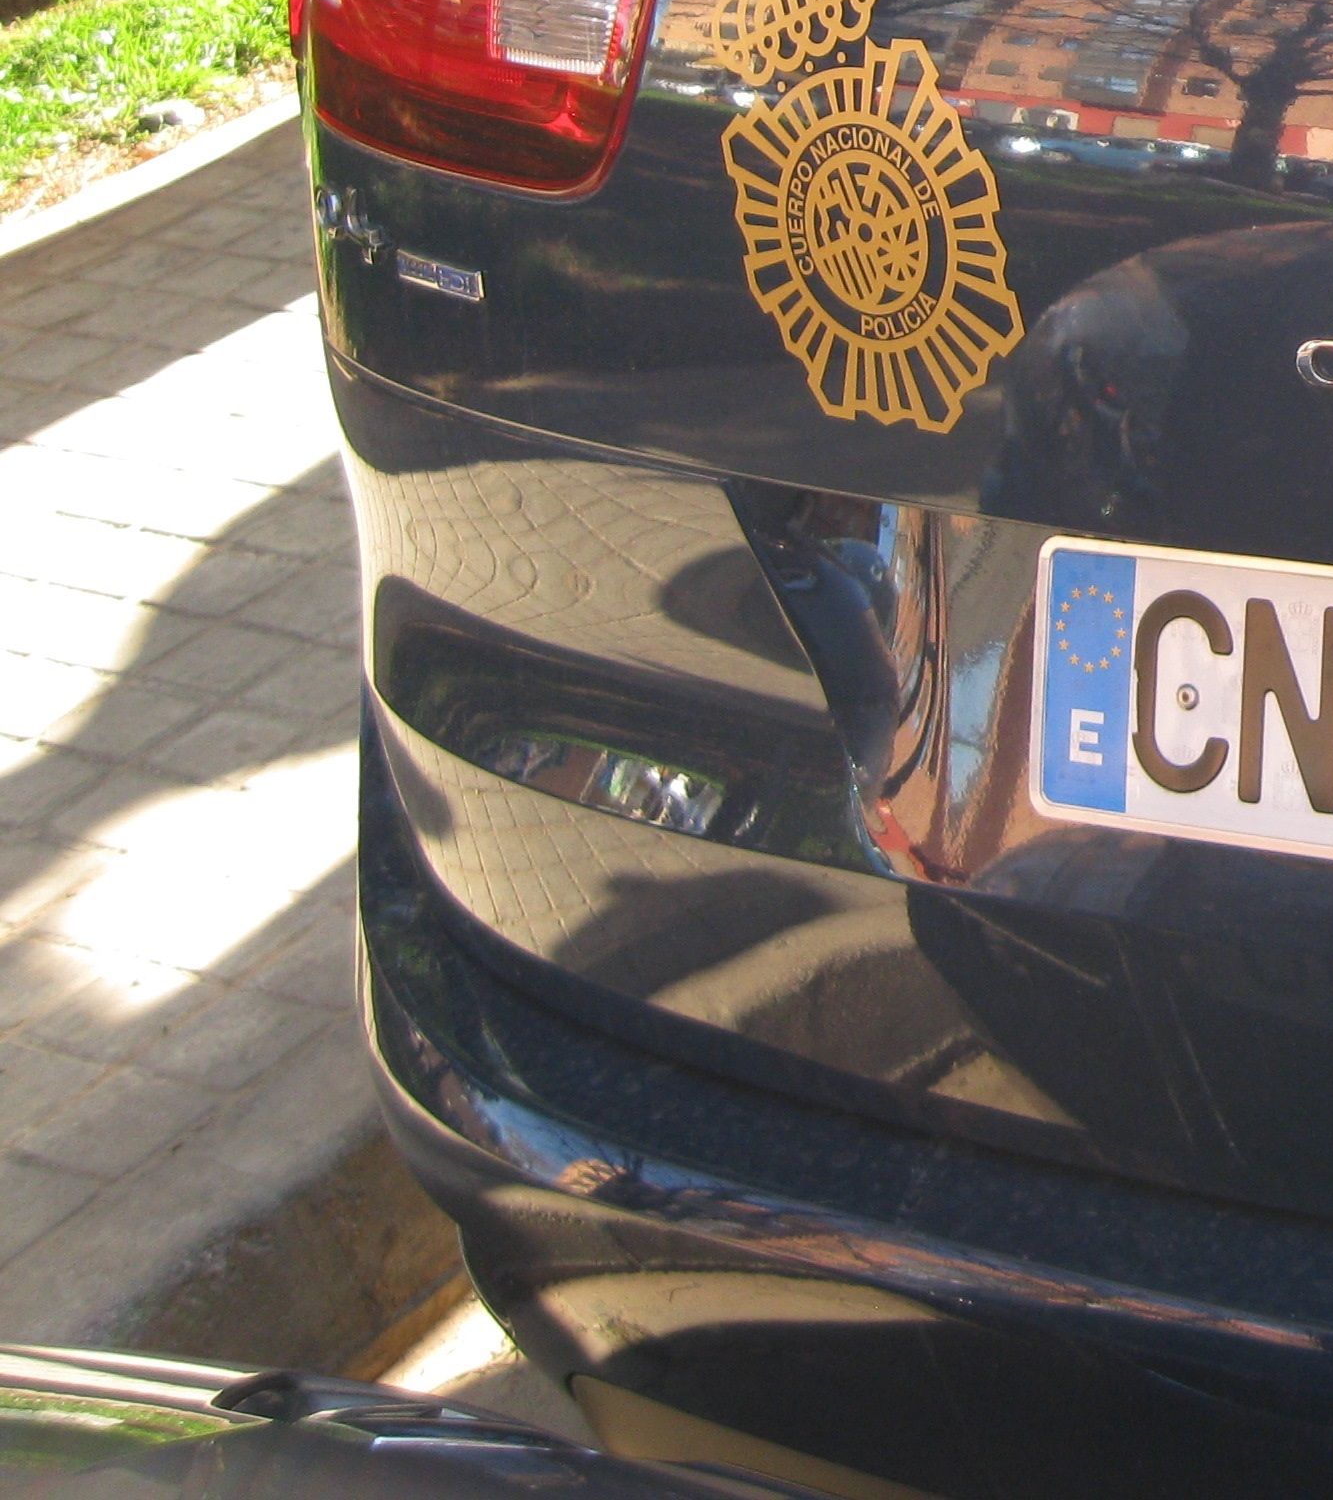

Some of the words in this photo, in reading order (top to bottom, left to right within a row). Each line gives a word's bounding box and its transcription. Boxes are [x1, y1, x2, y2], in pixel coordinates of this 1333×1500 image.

[787, 161, 815, 276] CUERPO
[809, 126, 912, 180] NACIONAL
[913, 179, 940, 220] DE
[859, 293, 938, 340] POLICIA
[1069, 708, 1105, 767] E
